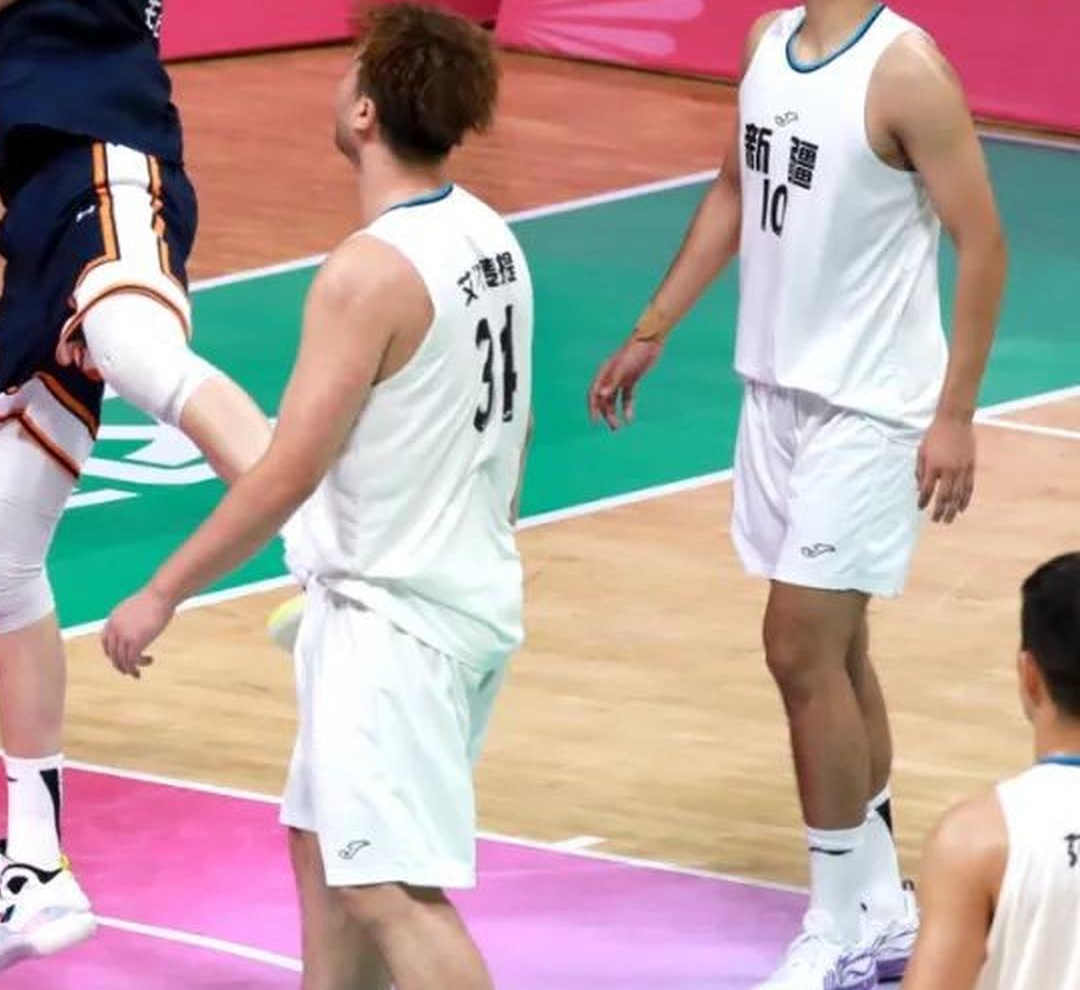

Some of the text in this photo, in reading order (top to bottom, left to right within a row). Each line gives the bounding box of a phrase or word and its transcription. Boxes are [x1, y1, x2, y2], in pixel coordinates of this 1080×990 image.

[745, 123, 819, 191] 新疆
[761, 178, 788, 238] 10
[473, 304, 517, 433] 31
